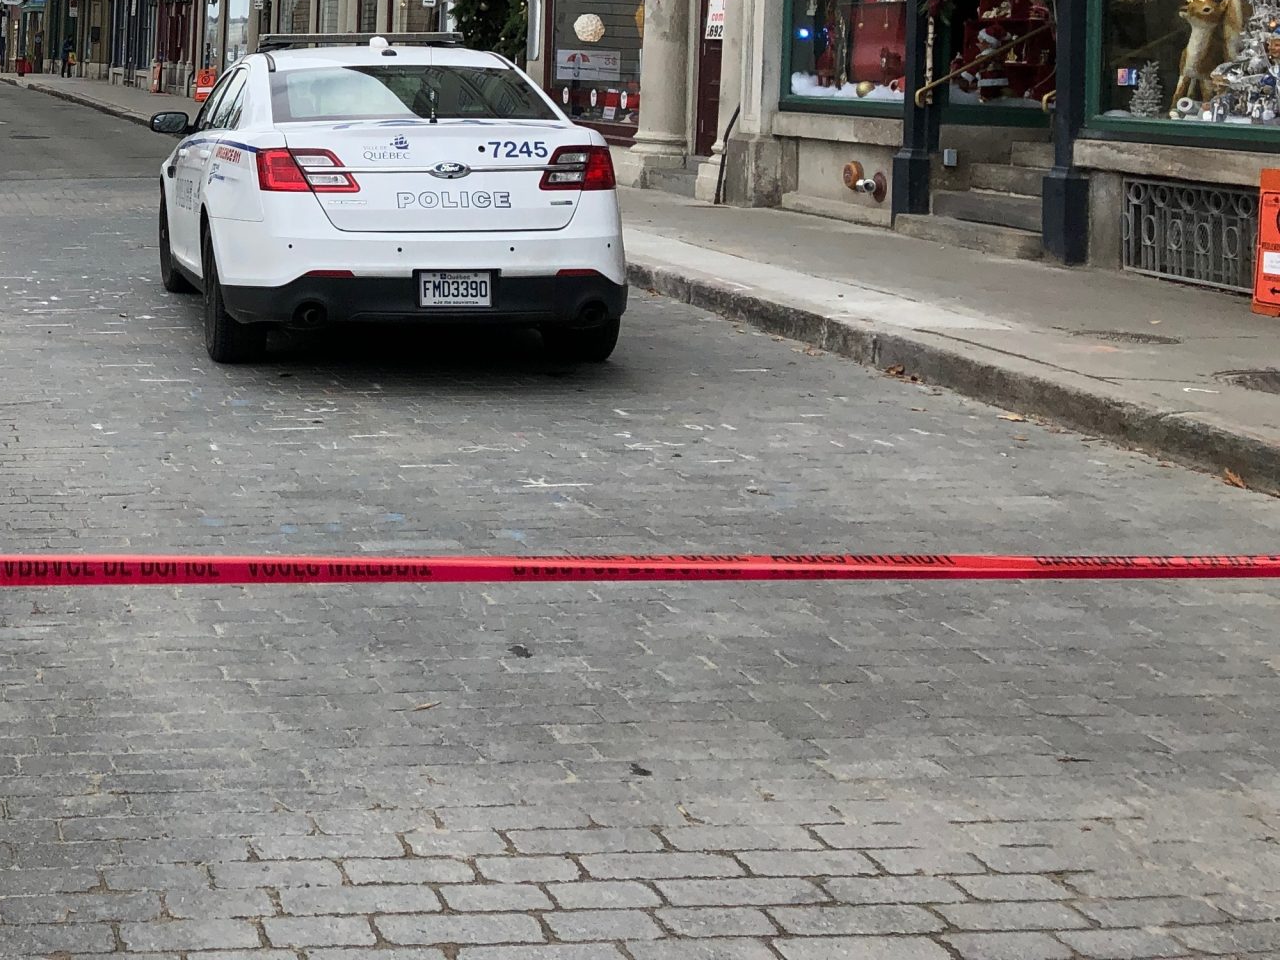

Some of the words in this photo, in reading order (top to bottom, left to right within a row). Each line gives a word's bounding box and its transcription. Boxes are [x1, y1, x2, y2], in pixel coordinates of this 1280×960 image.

[363, 149, 410, 161] QUÉBEC
[488, 141, 549, 158] 7245
[440, 163, 460, 173] Ford
[397, 191, 512, 209] POLICE
[423, 280, 488, 298] FMD3390
